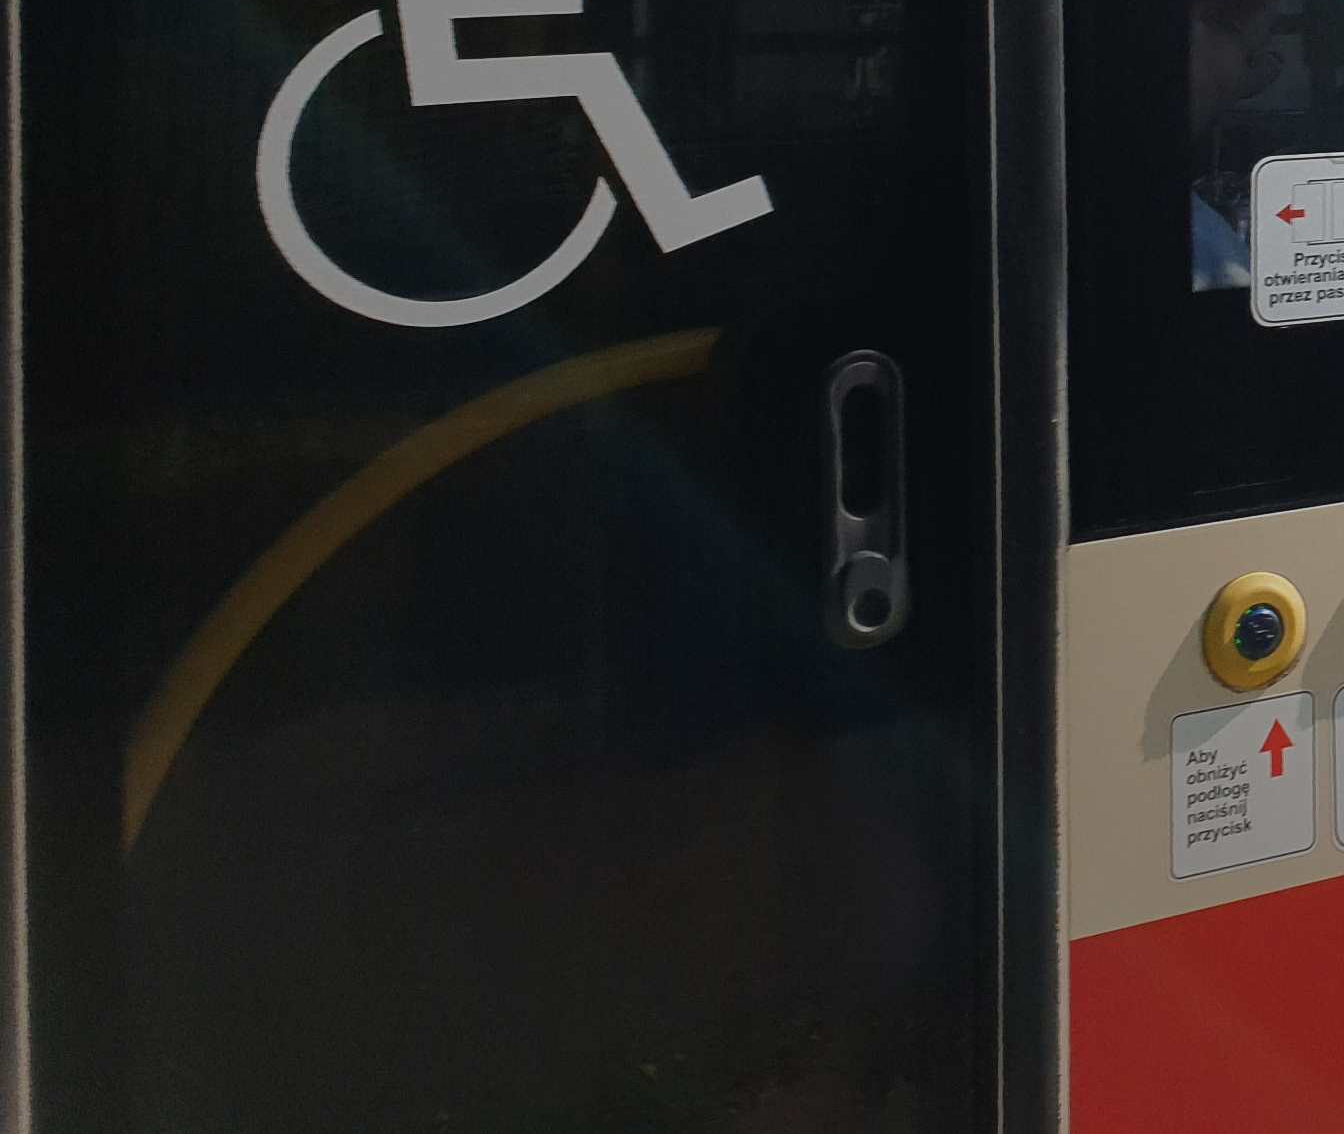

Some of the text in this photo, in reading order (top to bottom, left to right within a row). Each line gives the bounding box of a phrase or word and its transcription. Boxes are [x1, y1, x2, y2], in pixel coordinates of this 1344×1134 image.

[1263, 268, 1344, 288] otwierania
[1269, 291, 1312, 308] przez
[1186, 750, 1218, 767] Aby
[1186, 760, 1248, 786] obniżyć
[1186, 779, 1251, 807] podłogę
[1187, 798, 1249, 825] naciśnij
[1187, 818, 1252, 848] przycisk
